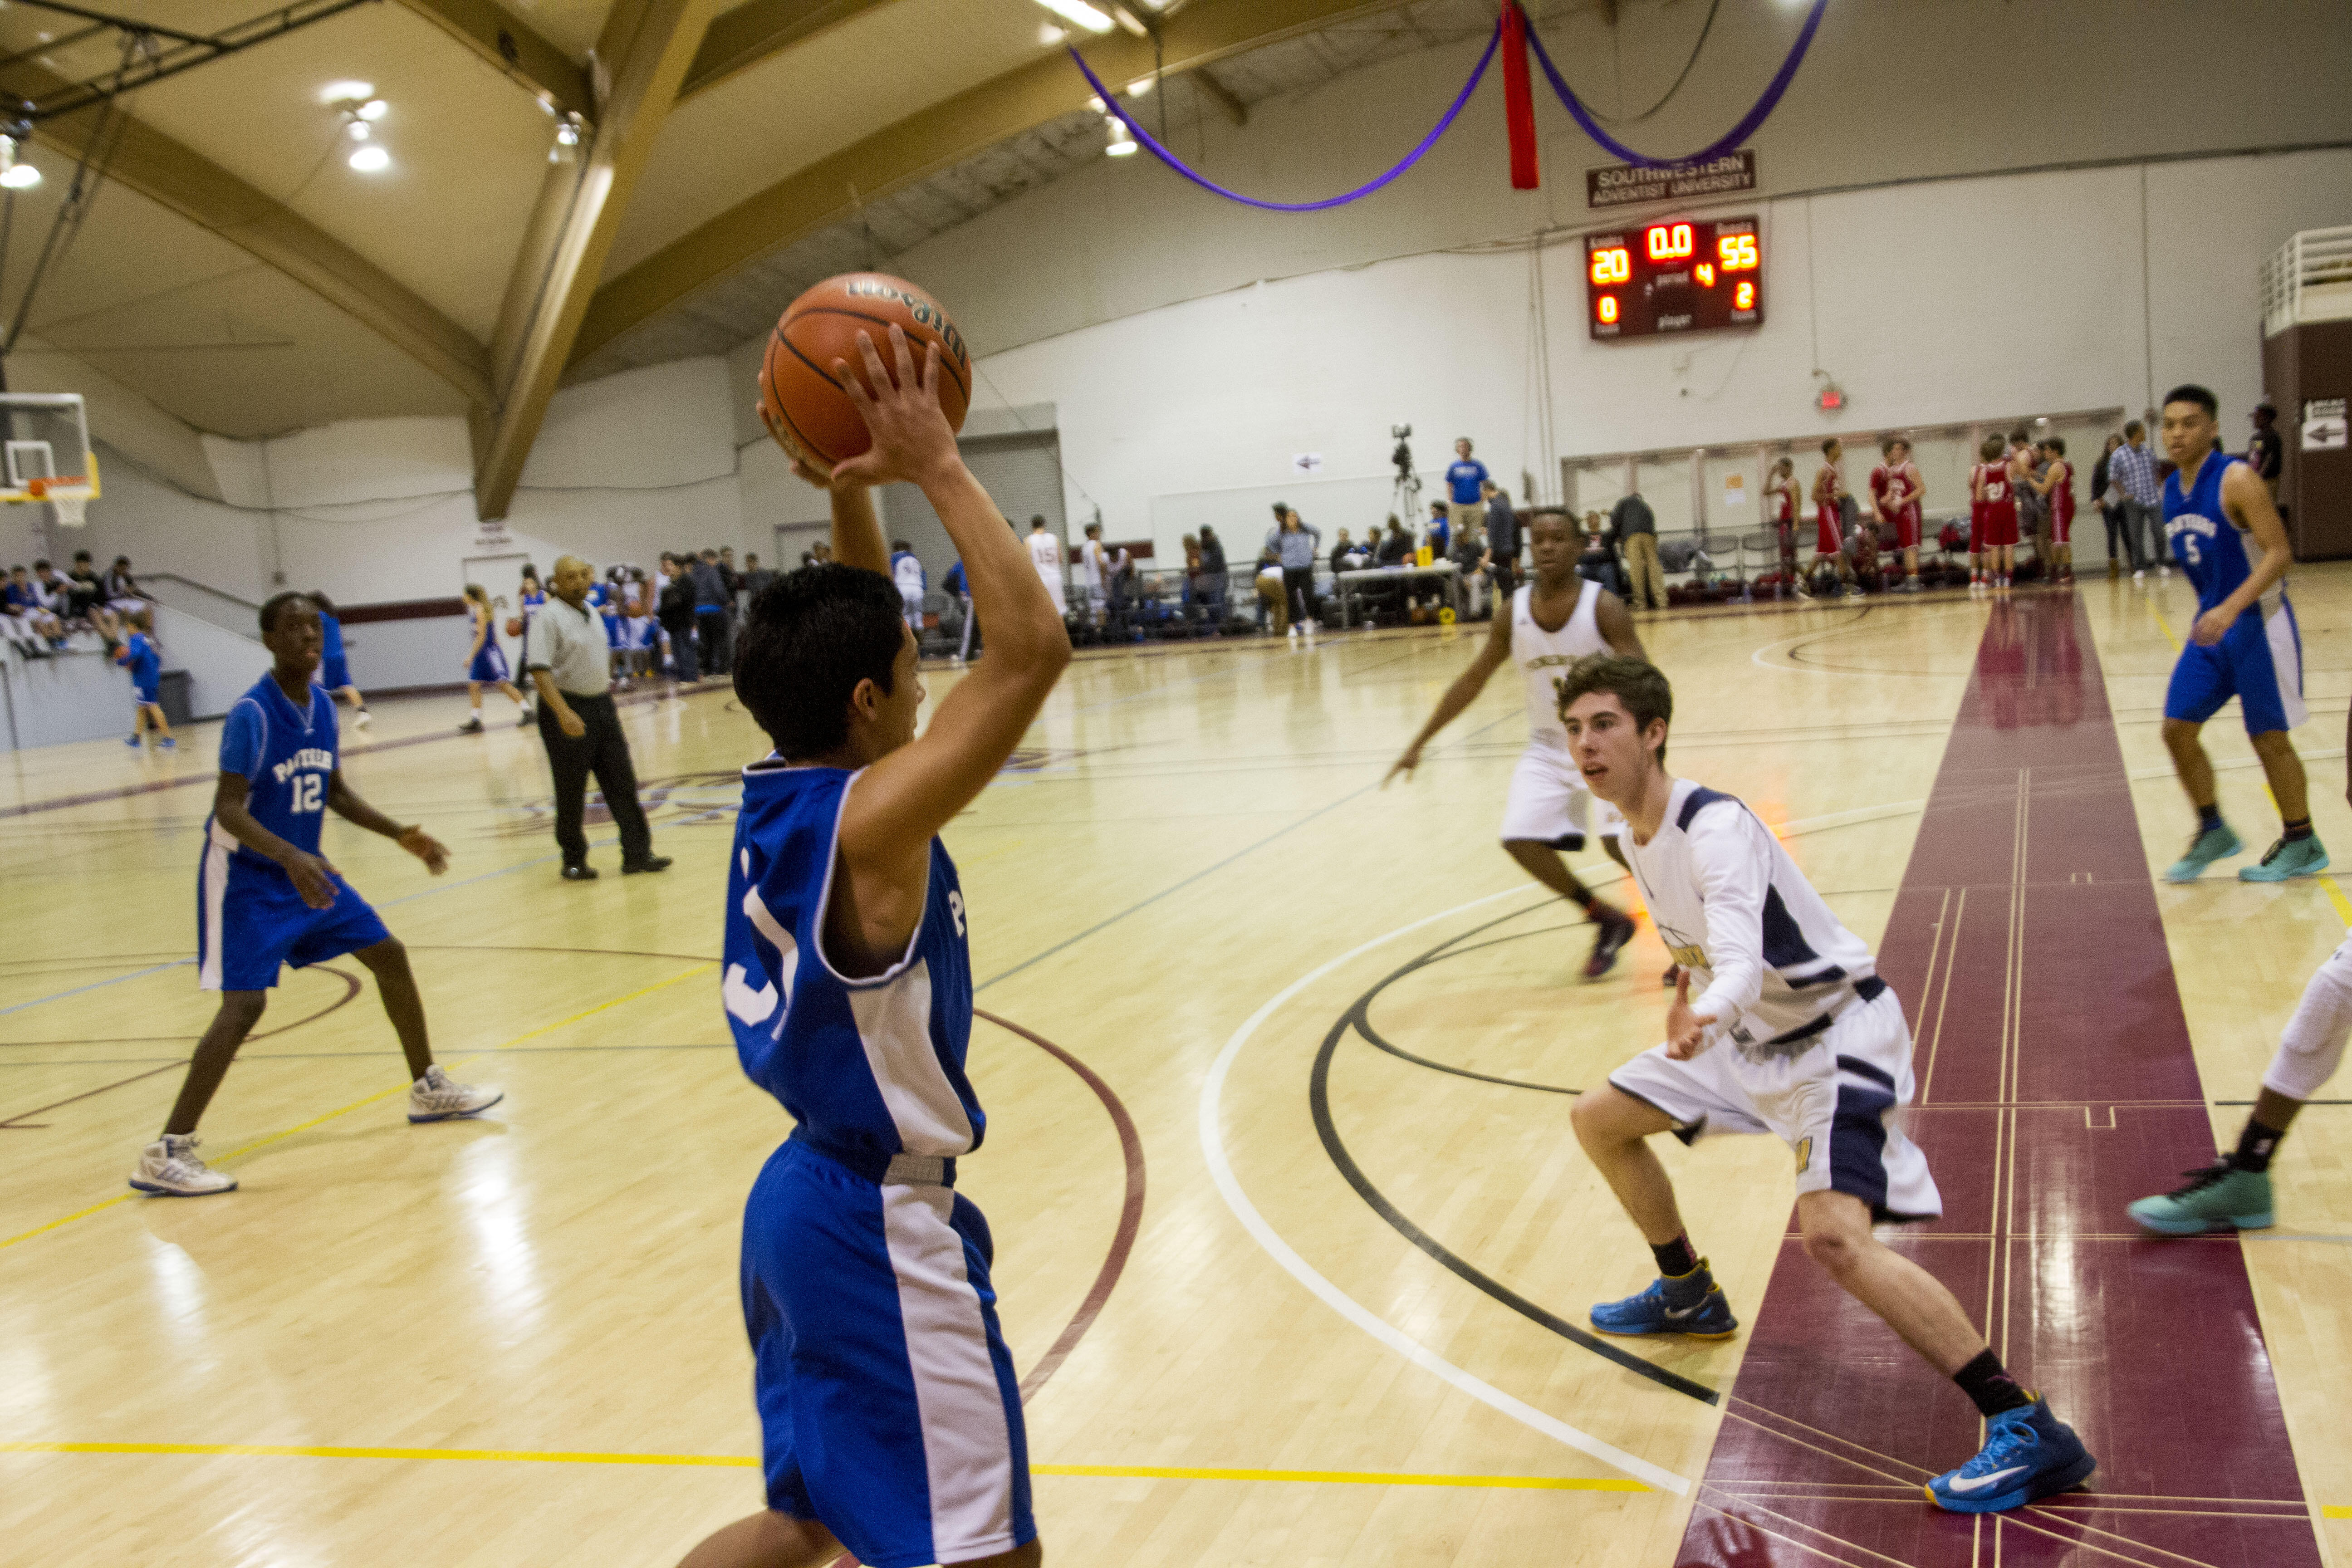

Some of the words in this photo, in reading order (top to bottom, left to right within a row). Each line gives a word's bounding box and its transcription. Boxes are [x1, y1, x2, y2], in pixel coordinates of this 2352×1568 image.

[1592, 182, 1666, 204] ADVENTIST
[1670, 173, 1751, 195] UNIVERSITY
[1648, 224, 1693, 260] 0.0
[1718, 234, 1759, 271] 55
[1592, 248, 1631, 284] 20
[1695, 263, 1715, 287] 4
[1598, 295, 1618, 323] 0
[1736, 281, 1754, 310] 2
[2185, 534, 2201, 565] 5
[291, 773, 323, 814] 12
